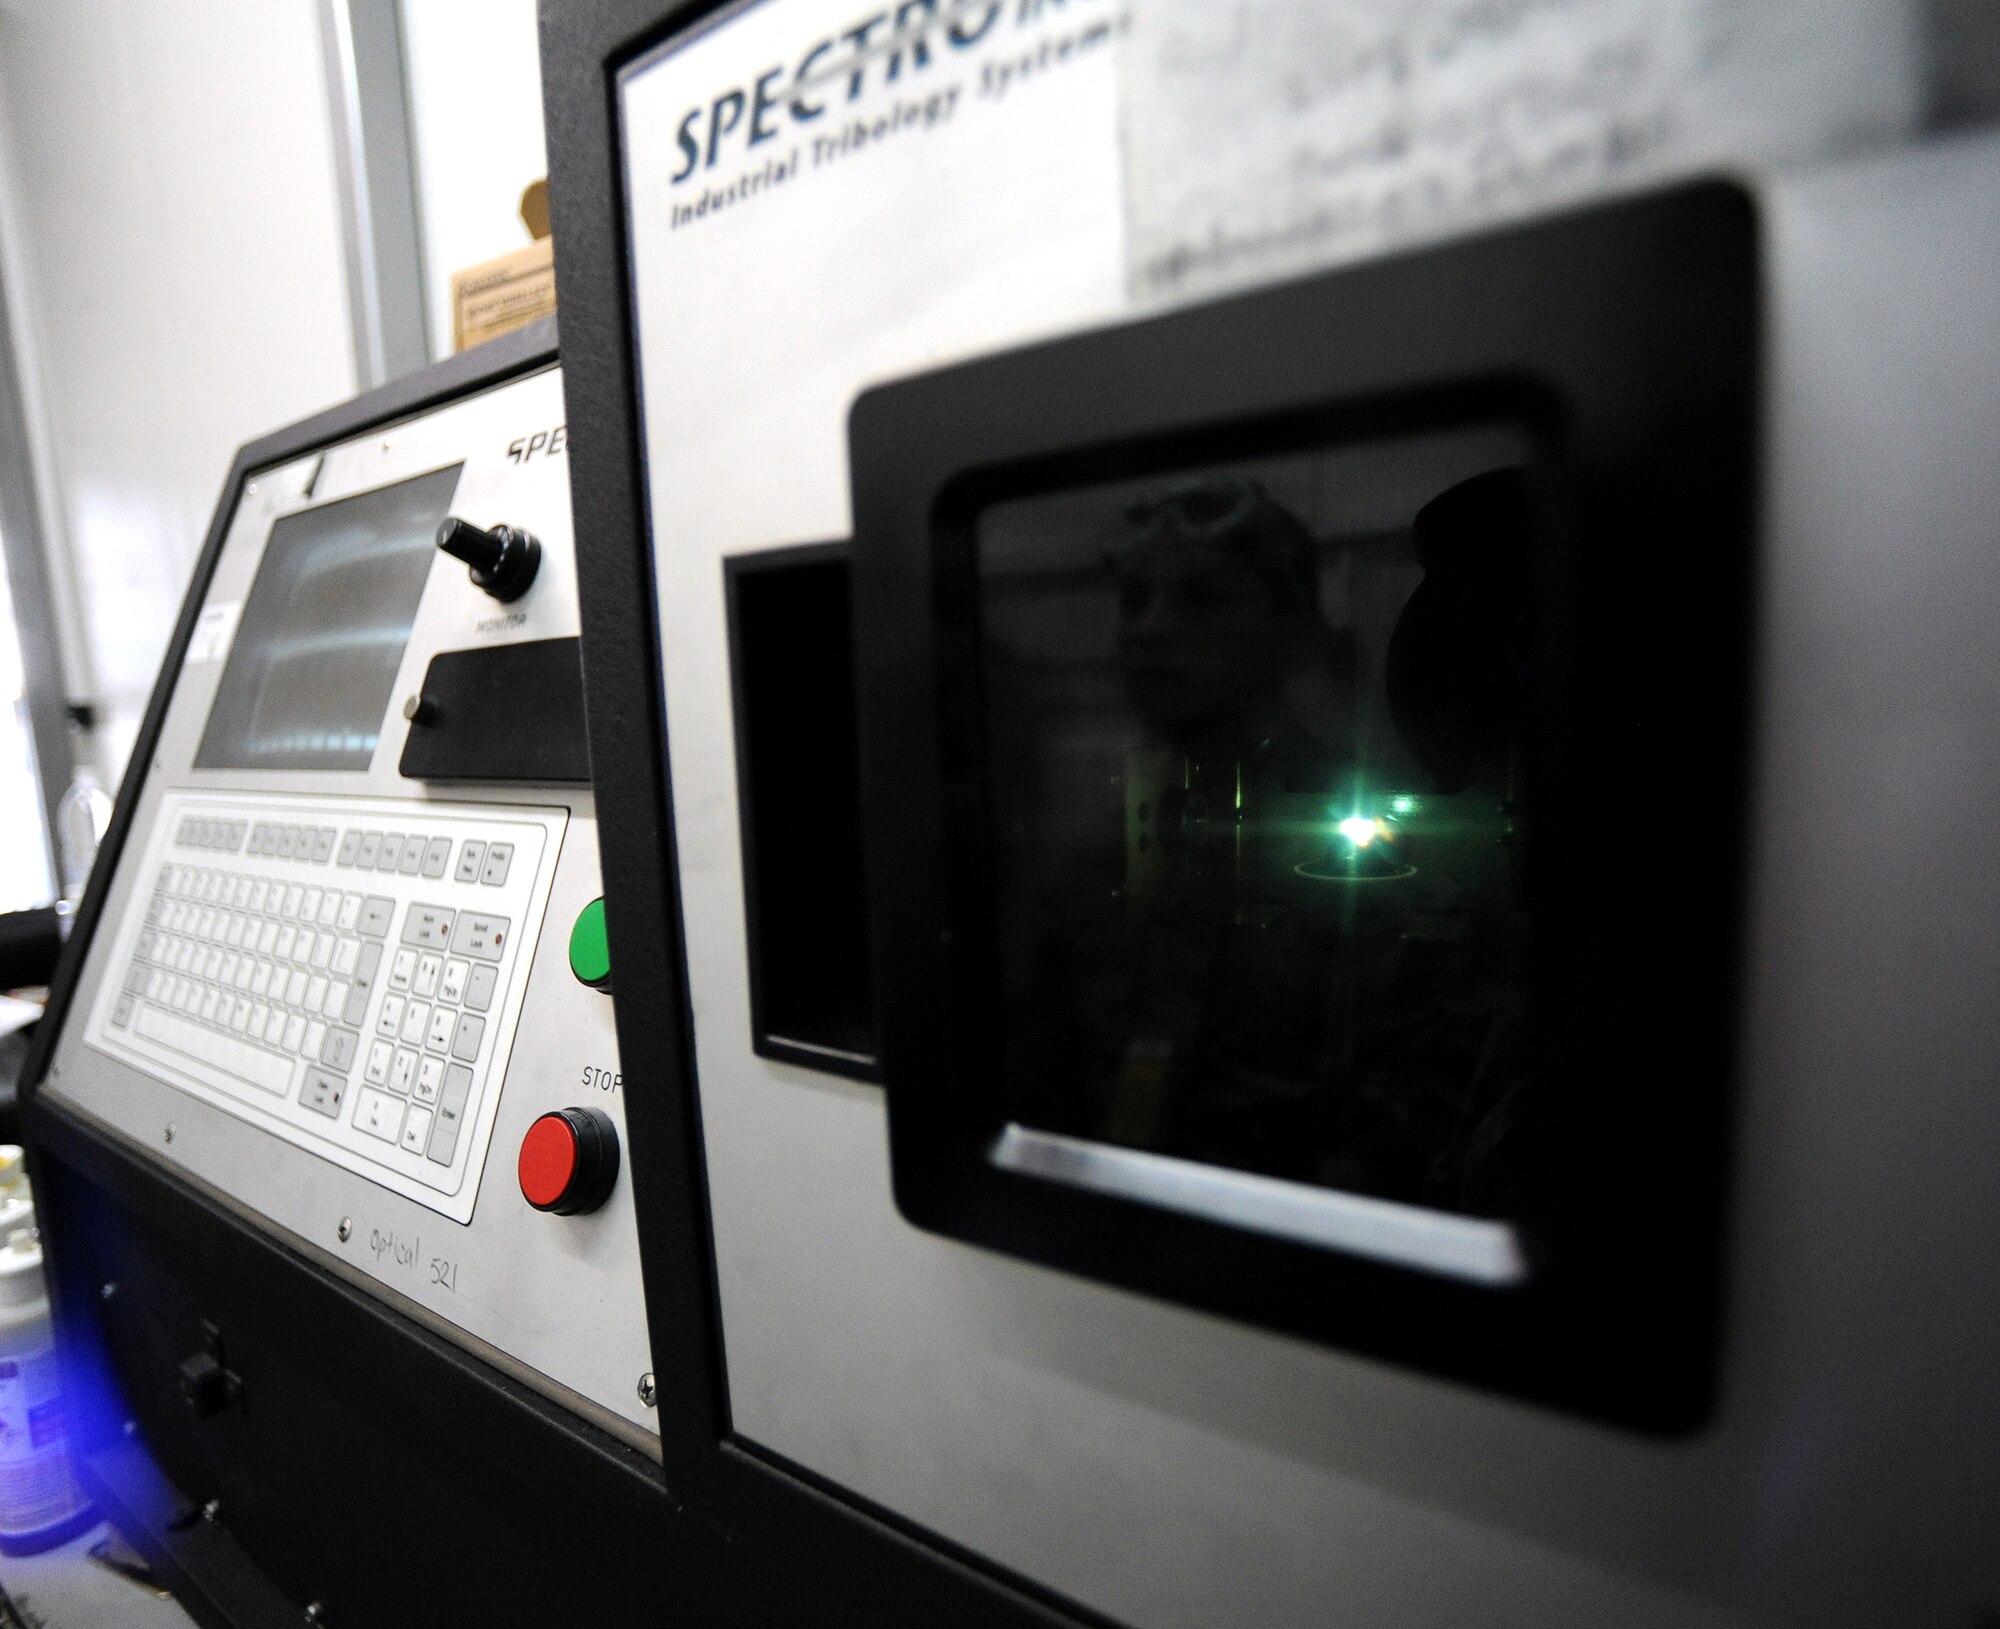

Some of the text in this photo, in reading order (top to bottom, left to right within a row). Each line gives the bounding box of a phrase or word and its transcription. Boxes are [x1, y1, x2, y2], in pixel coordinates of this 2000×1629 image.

[671, 150, 799, 231] Industrial
[812, 78, 963, 168] Tribology
[508, 425, 568, 464] SPE
[475, 612, 528, 635] MONITOR
[582, 1066, 623, 1093] STOP
[430, 1258, 458, 1293] 521
